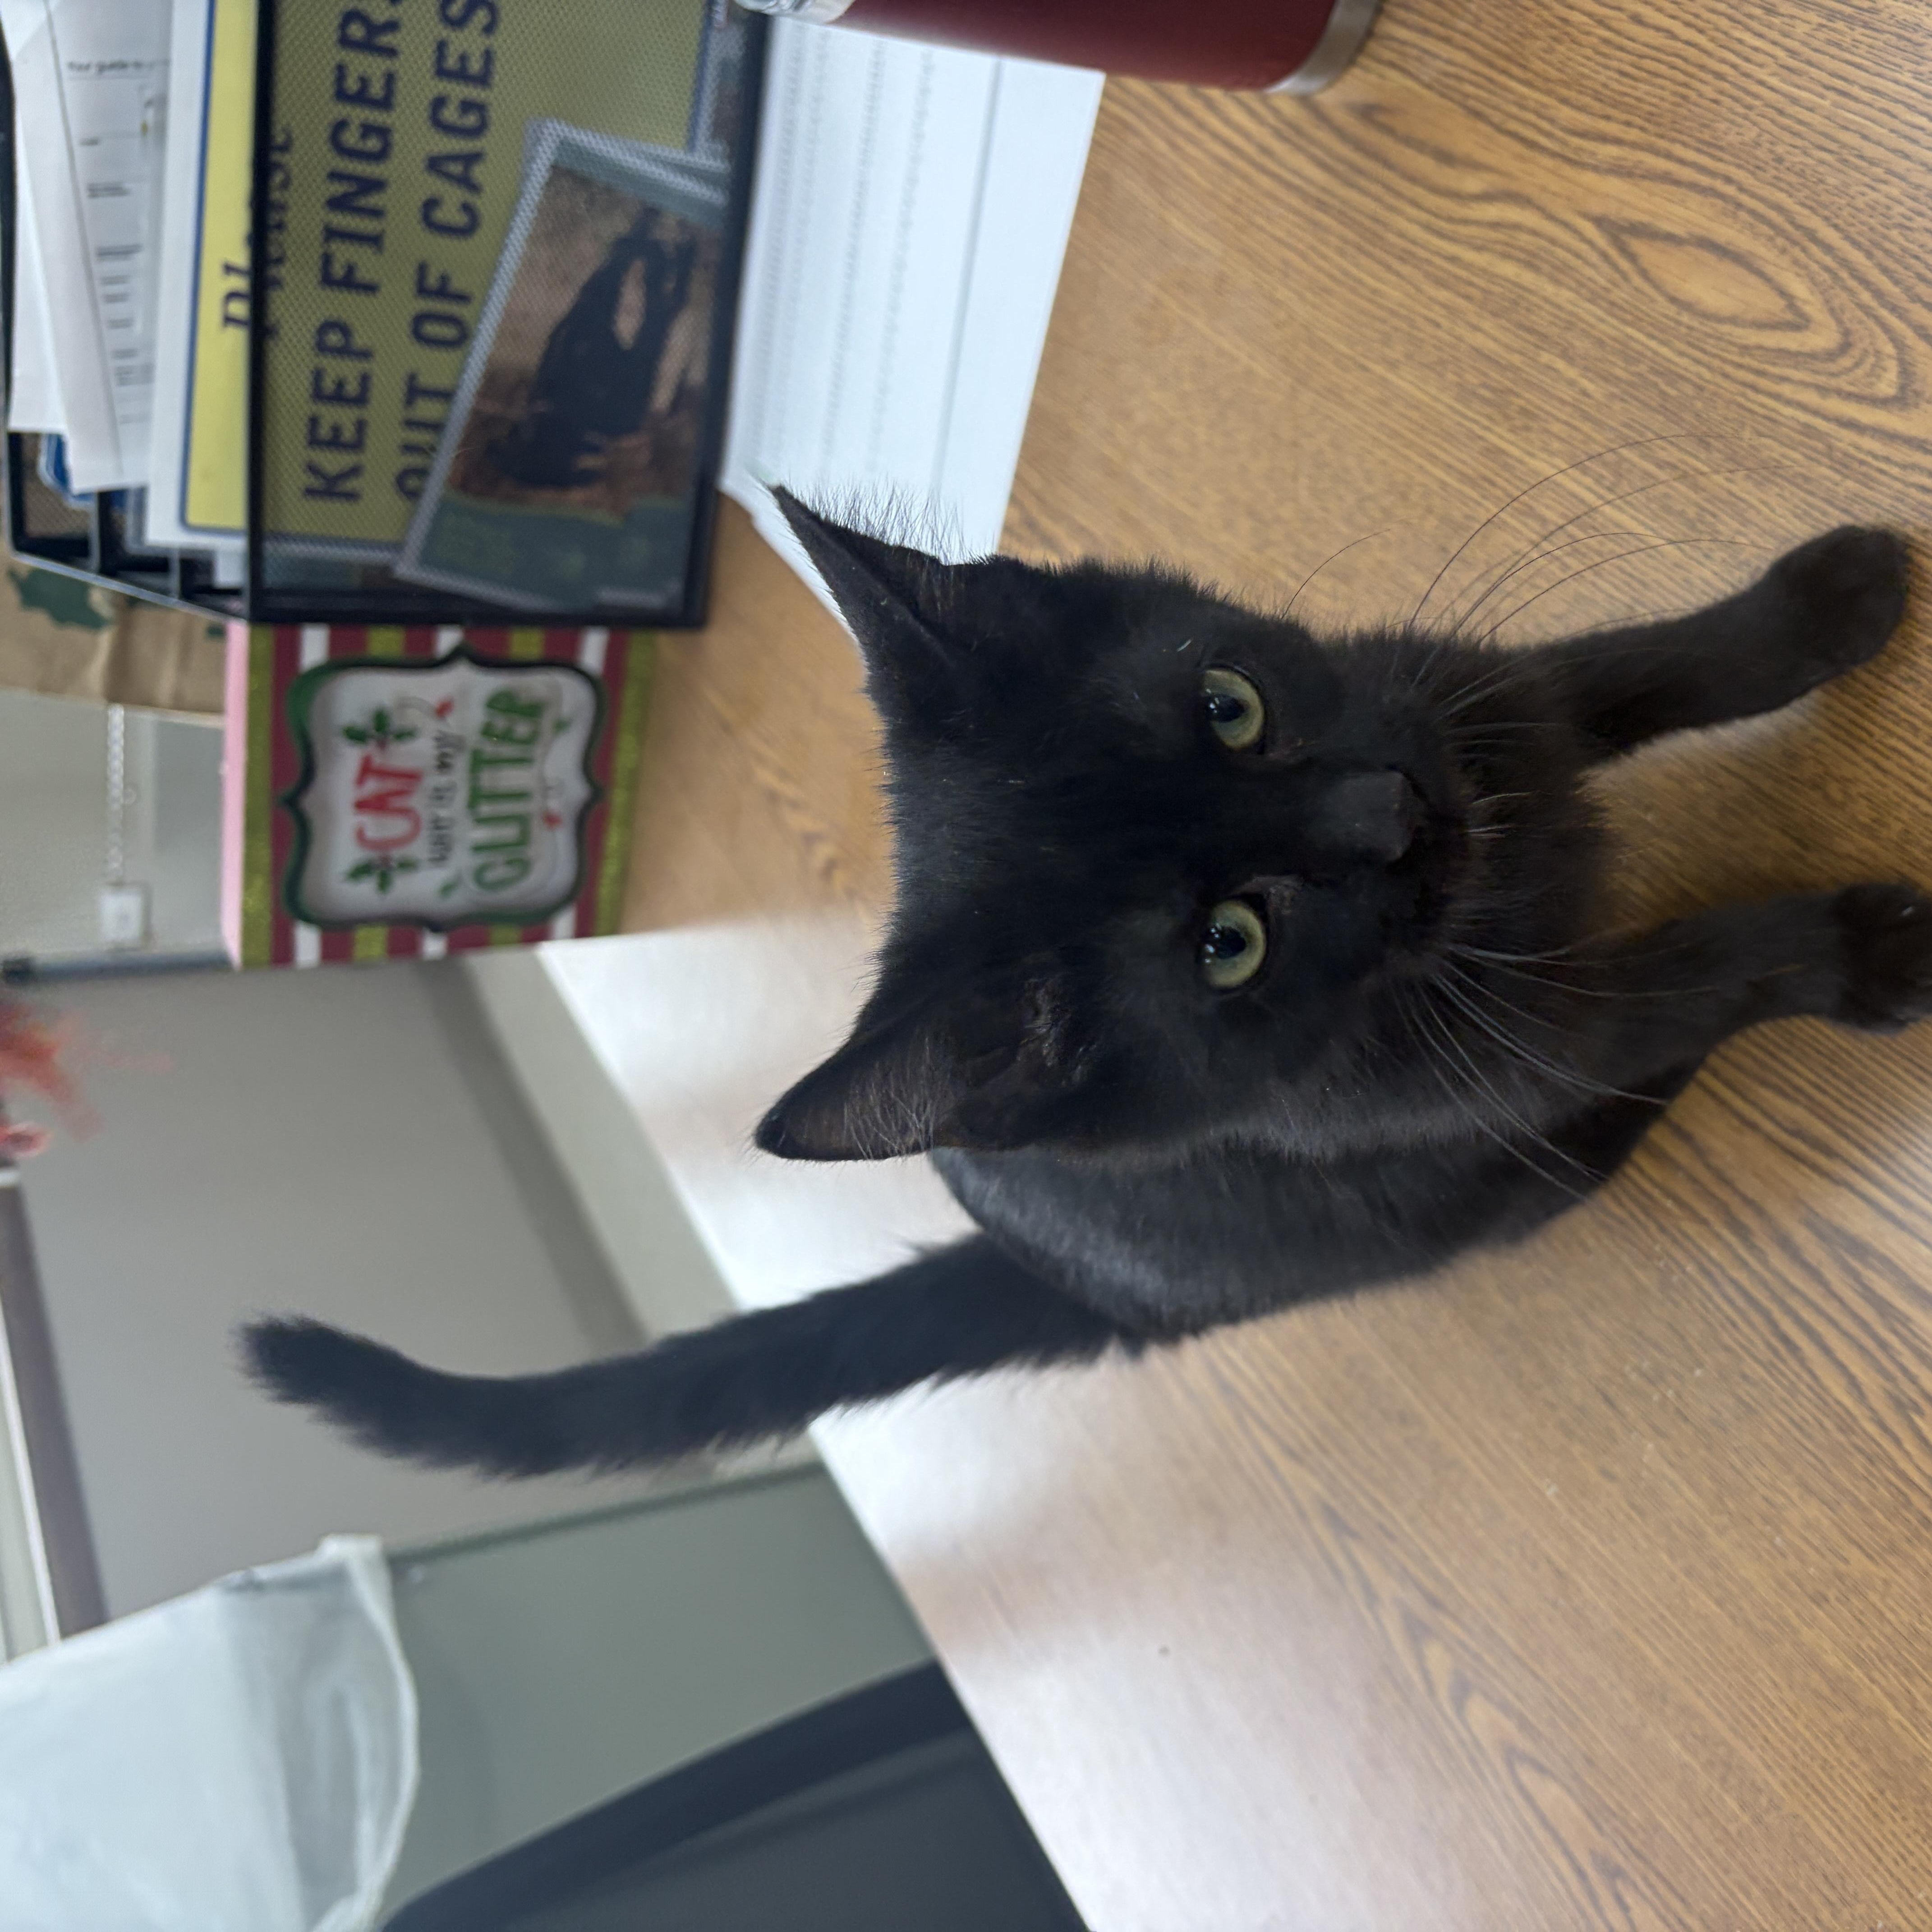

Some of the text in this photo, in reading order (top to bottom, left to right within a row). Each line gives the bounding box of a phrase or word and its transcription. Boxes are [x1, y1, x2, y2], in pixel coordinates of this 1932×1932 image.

[419, 0, 498, 240] CAGES
[303, 0, 403, 502] KEEP FINGER
[411, 262, 473, 351] OF
[354, 753, 423, 852] CAT
[467, 688, 546, 892] GLITTER
